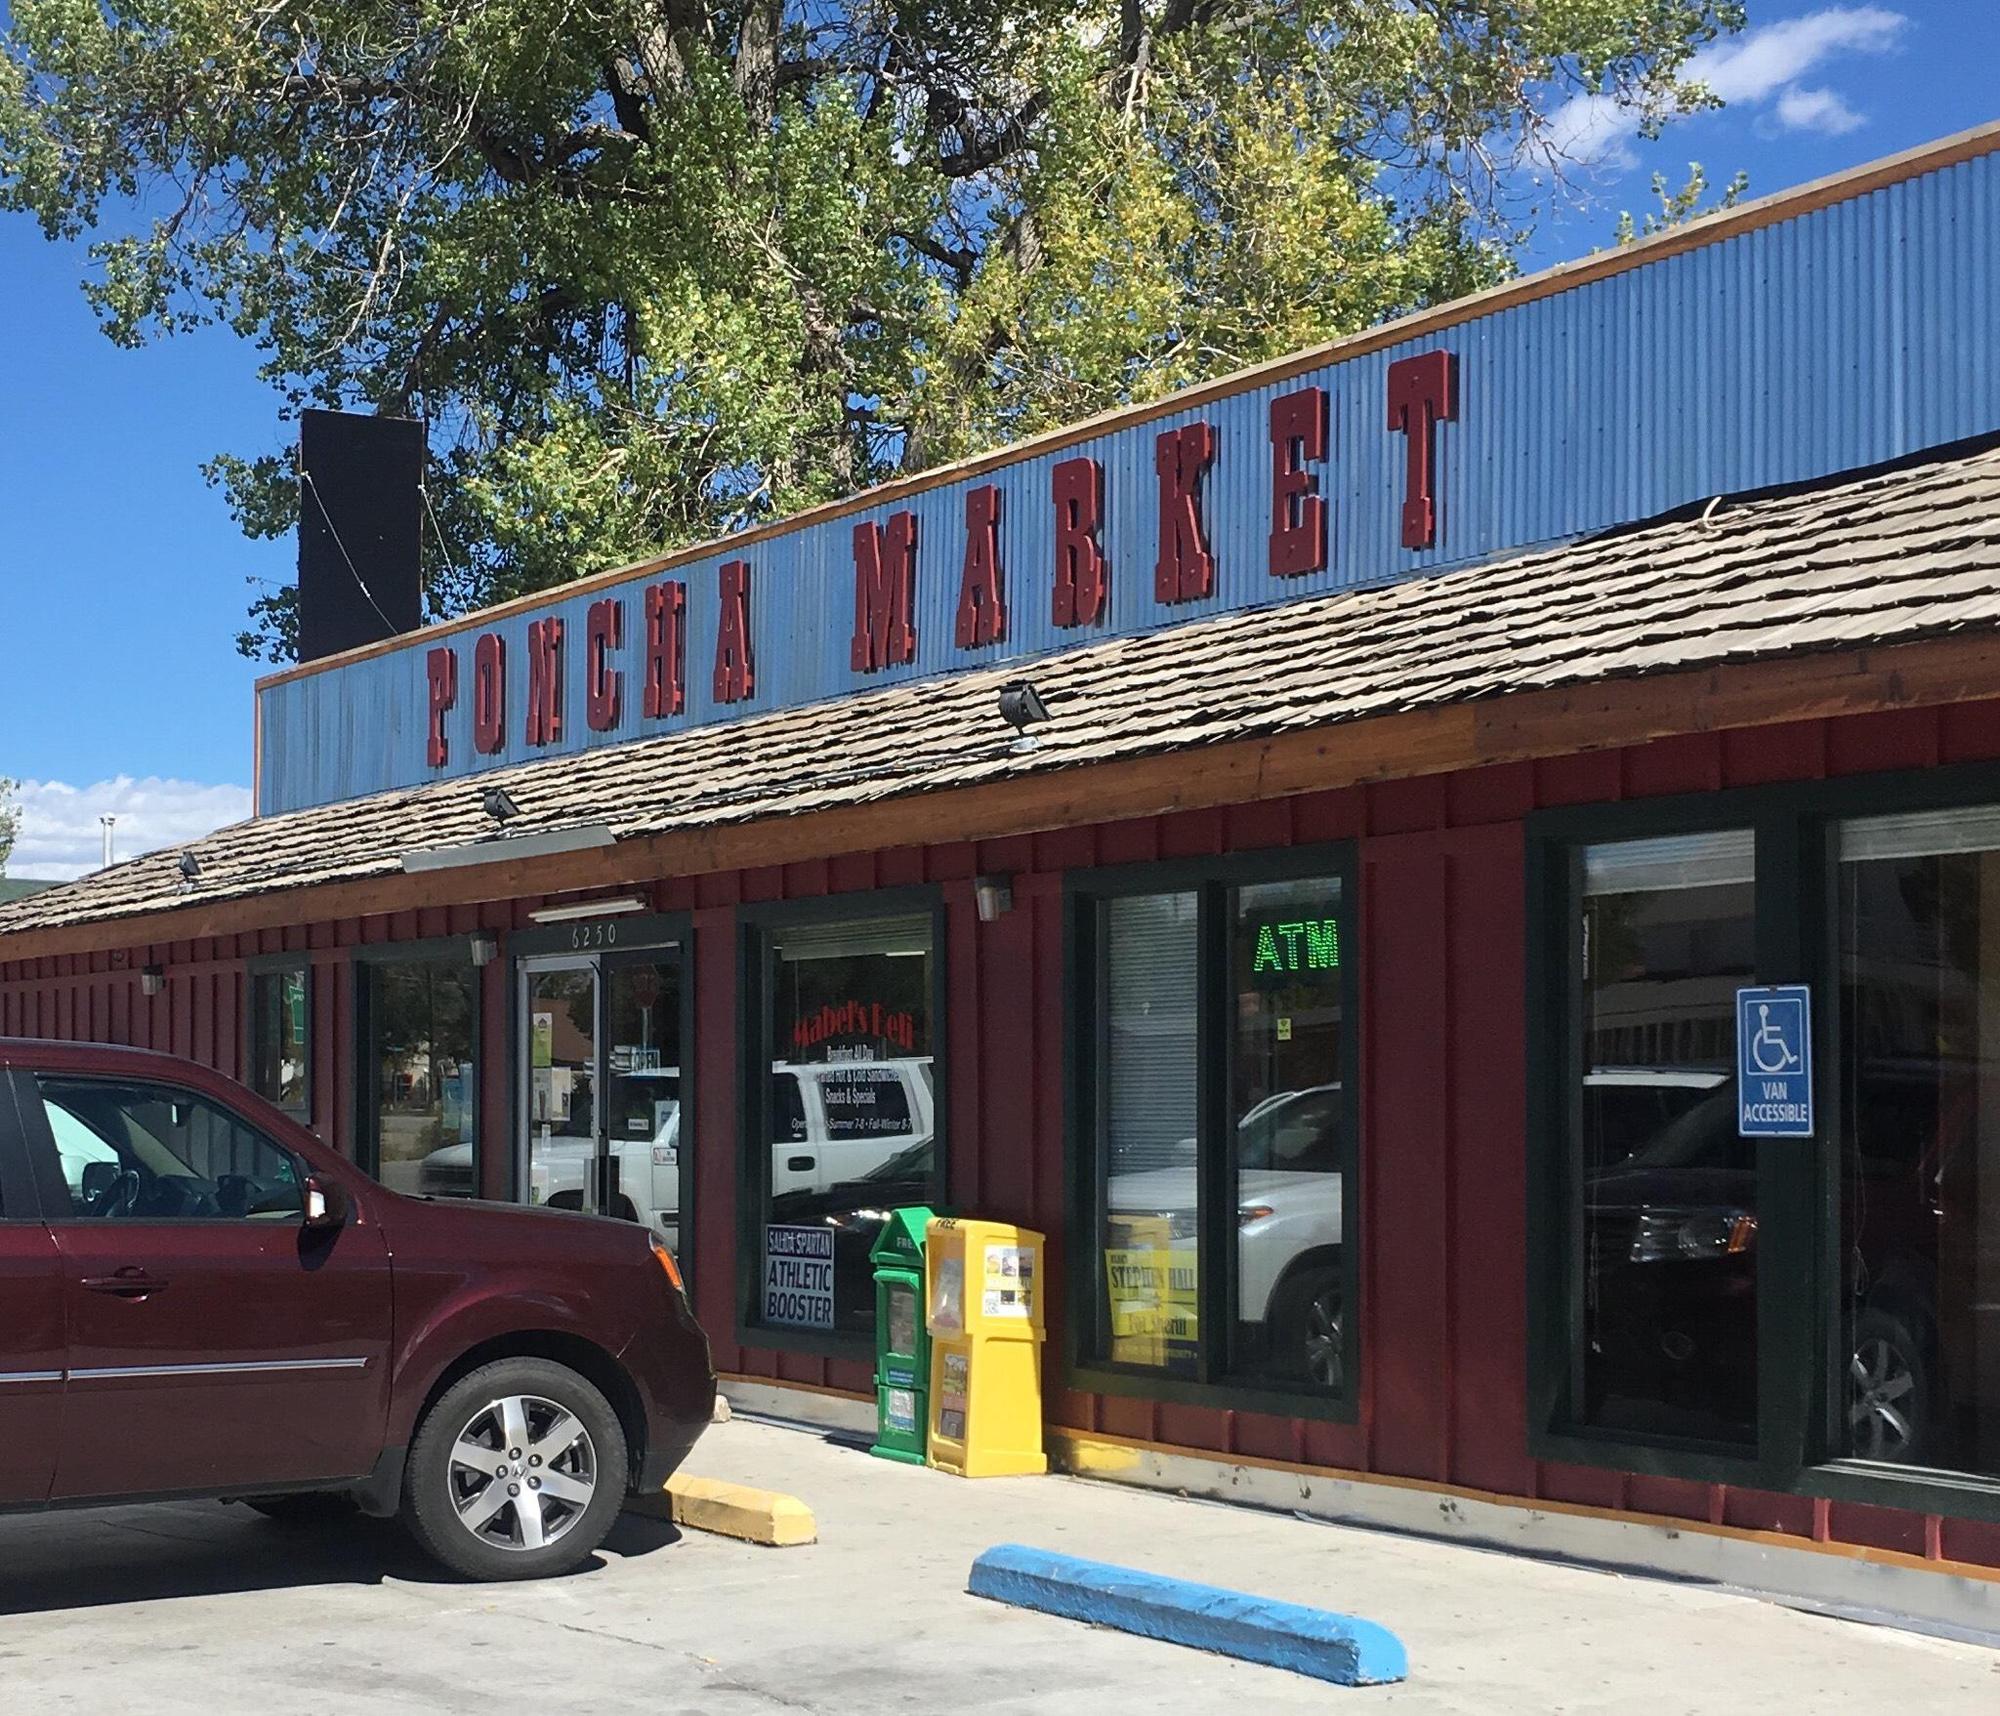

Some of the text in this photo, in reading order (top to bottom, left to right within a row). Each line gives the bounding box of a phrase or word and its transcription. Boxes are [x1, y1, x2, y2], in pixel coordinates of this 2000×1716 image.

[426, 348, 1455, 768] PONCHA MARKET
[572, 924, 616, 948] 6250
[1253, 920, 1339, 971] ATM
[825, 1086, 876, 1108] Snacks & Specials
[1762, 1081, 1787, 1100] VAN
[1744, 1103, 1808, 1123] ACCESSIBLE
[796, 1233, 831, 1256] SPARTAN
[768, 1260, 832, 1292] ATHLETIC
[768, 1292, 832, 1323] BOOSTER
